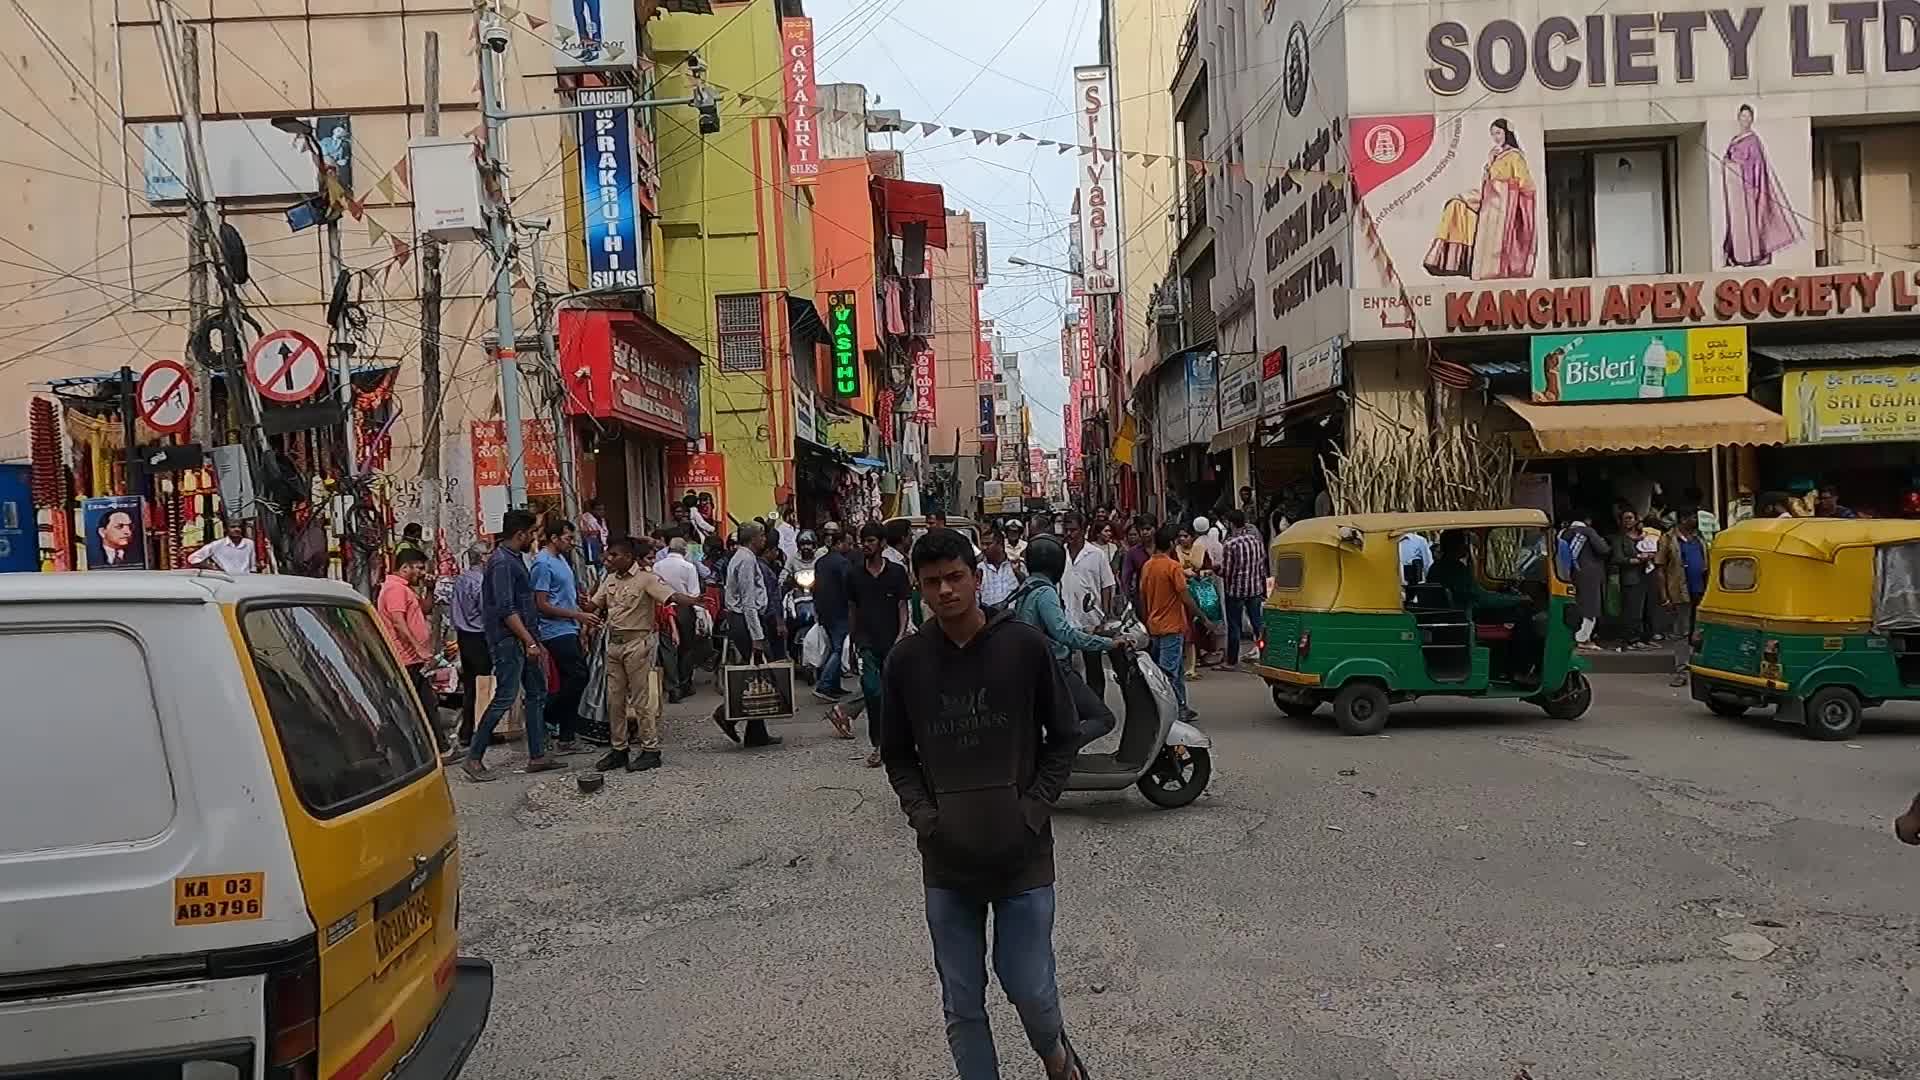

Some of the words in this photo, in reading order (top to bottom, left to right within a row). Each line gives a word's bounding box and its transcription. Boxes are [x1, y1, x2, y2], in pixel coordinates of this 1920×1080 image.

[1425, 7, 1764, 96] SOCIETY
[580, 91, 627, 104] KANCHI
[1425, 150, 1456, 184] wedding
[1450, 117, 1463, 147] sarees
[1266, 202, 1307, 275] KANCHI
[1273, 259, 1312, 320] SOCIETY
[1446, 286, 1591, 333] KANCHI
[1600, 281, 1706, 323] APEX
[1713, 272, 1884, 320] SOCIETY
[835, 309, 855, 393] VASTHU
[1565, 354, 1636, 386] Bisleri
[1840, 411, 1897, 425] SILKS
[177, 899, 259, 920] AB3796
[184, 882, 208, 897] KA
[226, 879, 251, 894] 03
